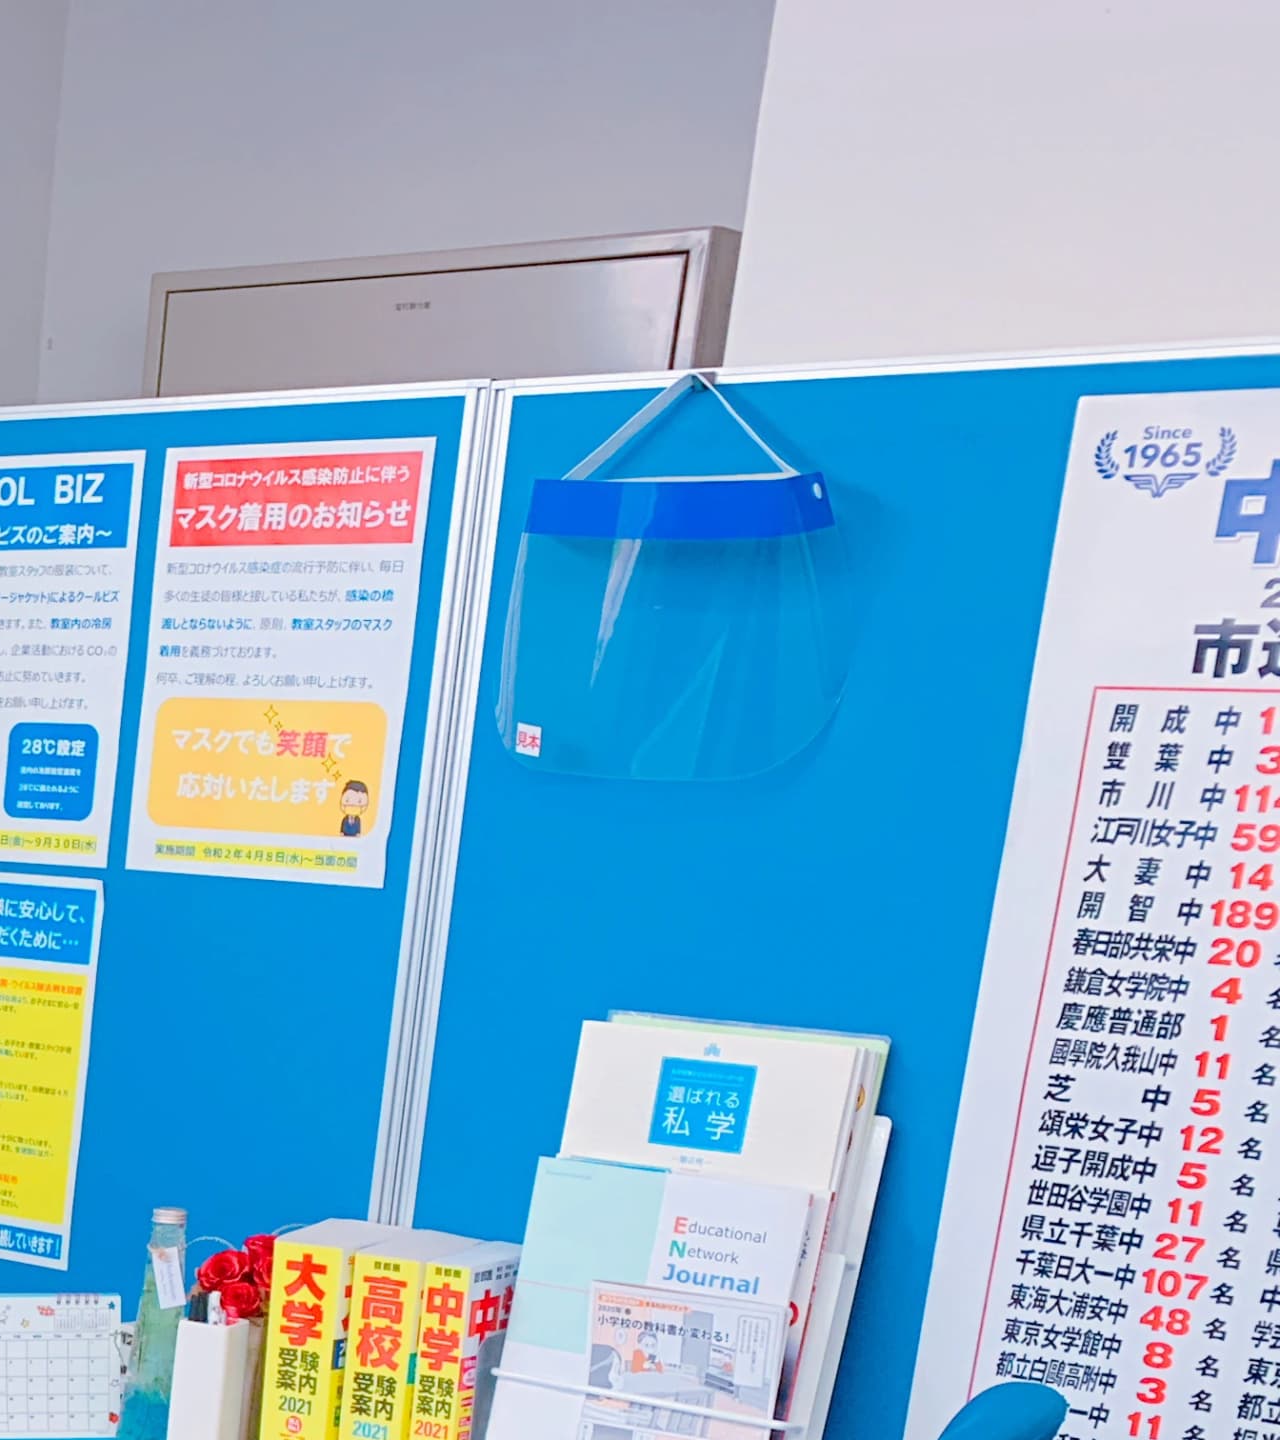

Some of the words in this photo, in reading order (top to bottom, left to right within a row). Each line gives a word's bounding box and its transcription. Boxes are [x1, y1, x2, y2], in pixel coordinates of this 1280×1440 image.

[1143, 424, 1193, 441] Since
[1122, 441, 1204, 471] 1965
[53, 472, 105, 505] BIZ
[184, 465, 411, 490] 新型コロナウイルス感染防止に伴う
[175, 498, 412, 532] マスク着用のお知らせ
[159, 644, 278, 660] 着用を義務づけております。
[1109, 704, 1242, 736] 開成中
[172, 727, 353, 759] マスクでも笑顔で
[1103, 741, 1234, 774] 雙葉中
[176, 771, 336, 804] 応対いたします
[1098, 778, 1227, 813] 市川中
[1234, 784, 1280, 813] 11
[154, 843, 196, 857] 実施期間
[1090, 816, 1219, 850] 江戸川女子中
[1230, 822, 1280, 854] 59
[1083, 854, 1212, 889] 大妻中
[1230, 861, 1275, 891] 14
[1076, 891, 1203, 927] 開智中
[1210, 899, 1279, 931] 189
[1071, 927, 1198, 966] 春日部共栄中
[1207, 937, 1262, 968] 20
[1062, 966, 1191, 1003] 鎌倉女学院中
[1210, 977, 1243, 1006] 4
[1055, 1001, 1187, 1041] 慶應普通部
[1209, 1014, 1230, 1042] 1
[1048, 1037, 1179, 1077] 國學院久我山中
[1195, 1051, 1232, 1081] 11
[665, 1085, 740, 1109] 選ばれる
[1190, 1088, 1222, 1117] 5
[1038, 1109, 1164, 1149] 頌栄女子中
[1180, 1124, 1226, 1155] 12
[1237, 1136, 1263, 1160] 名
[1031, 1144, 1158, 1185] 逗子開成中
[1176, 1161, 1208, 1190] 5
[1026, 1179, 1153, 1221] 世田谷学園中
[1167, 1197, 1204, 1228] 11
[1223, 1209, 1249, 1234] 名
[673, 1215, 768, 1245] Educational
[1019, 1214, 1145, 1256] 県立千葉中
[1152, 1232, 1207, 1264] 27
[668, 1240, 740, 1266] Network
[662, 1262, 761, 1296] Journal
[1015, 1249, 1138, 1291] 千葉日大一中
[1141, 1267, 1209, 1301] 107
[279, 1252, 328, 1347] 大学
[1007, 1283, 1130, 1325] 東海大浦安中
[1139, 1305, 1192, 1336] 48
[1202, 1317, 1228, 1342] 名
[355, 1275, 408, 1372] 高校
[419, 1282, 466, 1372] 中学
[278, 1346, 320, 1374] 受験
[1000, 1317, 1123, 1361] 東京女学館中
[1142, 1341, 1175, 1370] 8
[1195, 1354, 1220, 1379] 名
[275, 1369, 318, 1397] 案内
[352, 1371, 398, 1400] 受験
[418, 1374, 454, 1400] 受験
[1136, 1376, 1168, 1405] 3
[277, 1394, 313, 1416] 2021
[350, 1395, 395, 1423] 案内
[415, 1395, 452, 1420] 案内
[351, 1419, 390, 1440] 2021
[414, 1419, 449, 1440] 2021
[1127, 1411, 1163, 1440] 11
